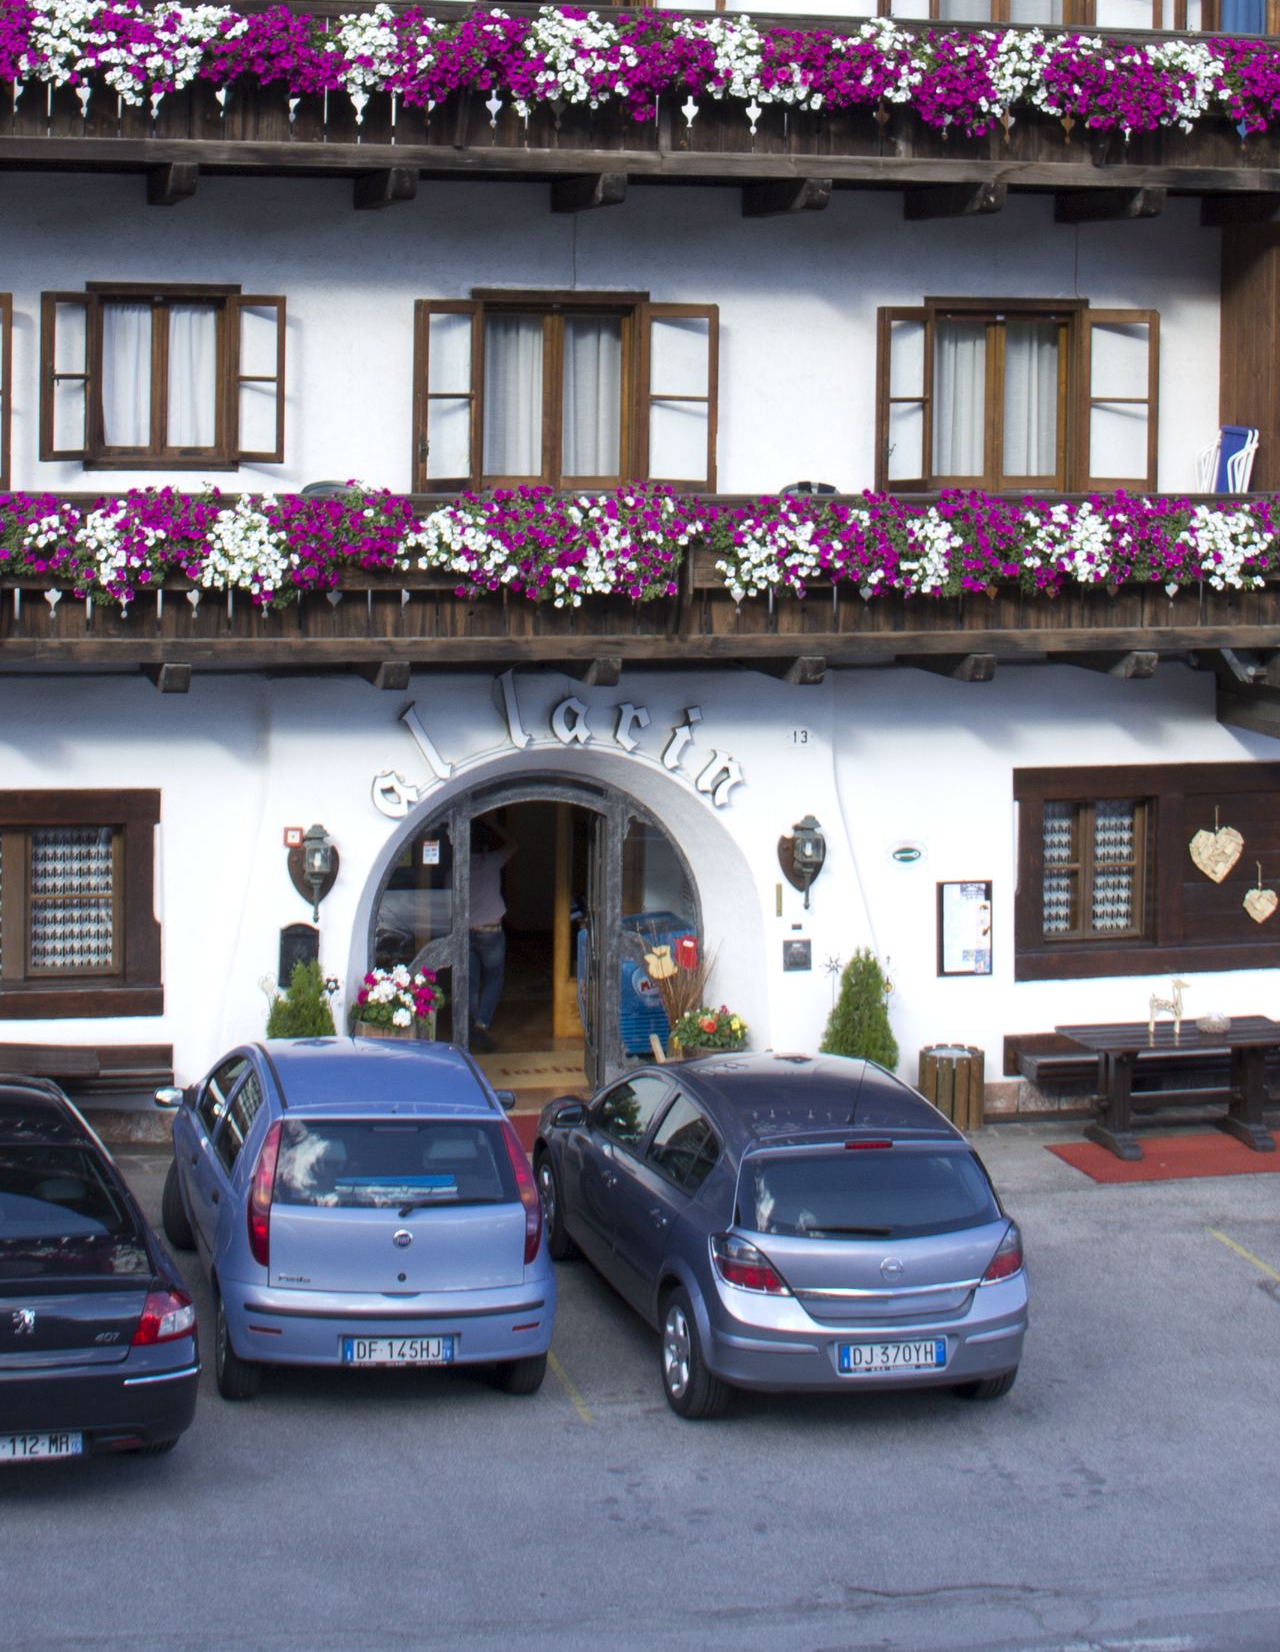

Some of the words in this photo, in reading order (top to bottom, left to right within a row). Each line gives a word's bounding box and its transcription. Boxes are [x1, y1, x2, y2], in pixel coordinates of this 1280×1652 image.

[493, 666, 745, 808] larin
[793, 729, 808, 744] 13
[356, 1340, 379, 1360] DF
[387, 1339, 442, 1360] 145HJ
[853, 1346, 874, 1367] DJ
[880, 1342, 934, 1364] 370YH
